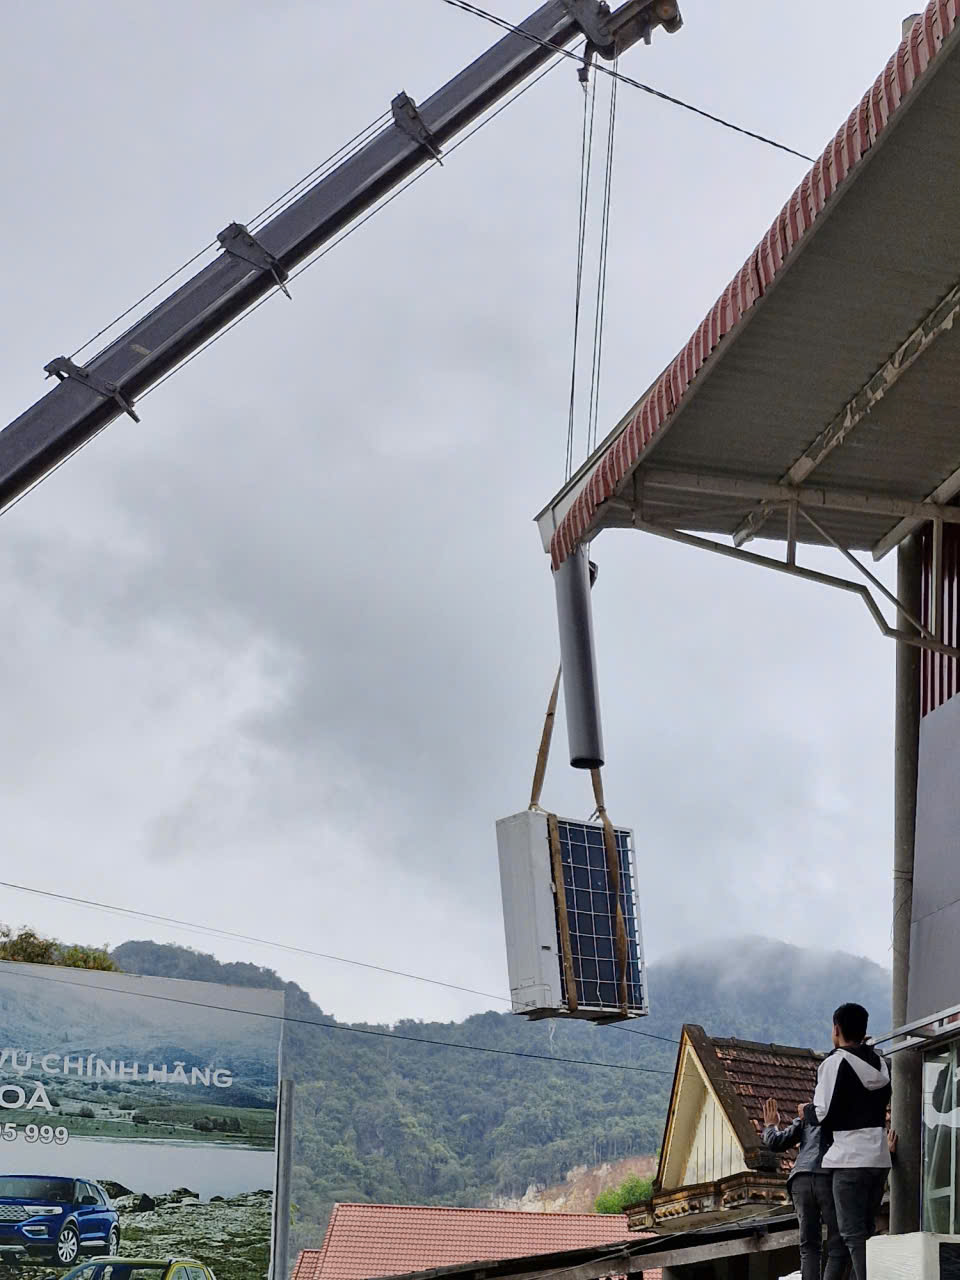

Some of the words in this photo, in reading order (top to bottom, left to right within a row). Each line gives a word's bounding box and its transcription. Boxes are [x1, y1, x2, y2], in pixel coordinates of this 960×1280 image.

[41, 1053, 138, 1081] CHÍNH
[148, 1061, 233, 1087] HÃNG
[24, 1124, 69, 1145] 999
